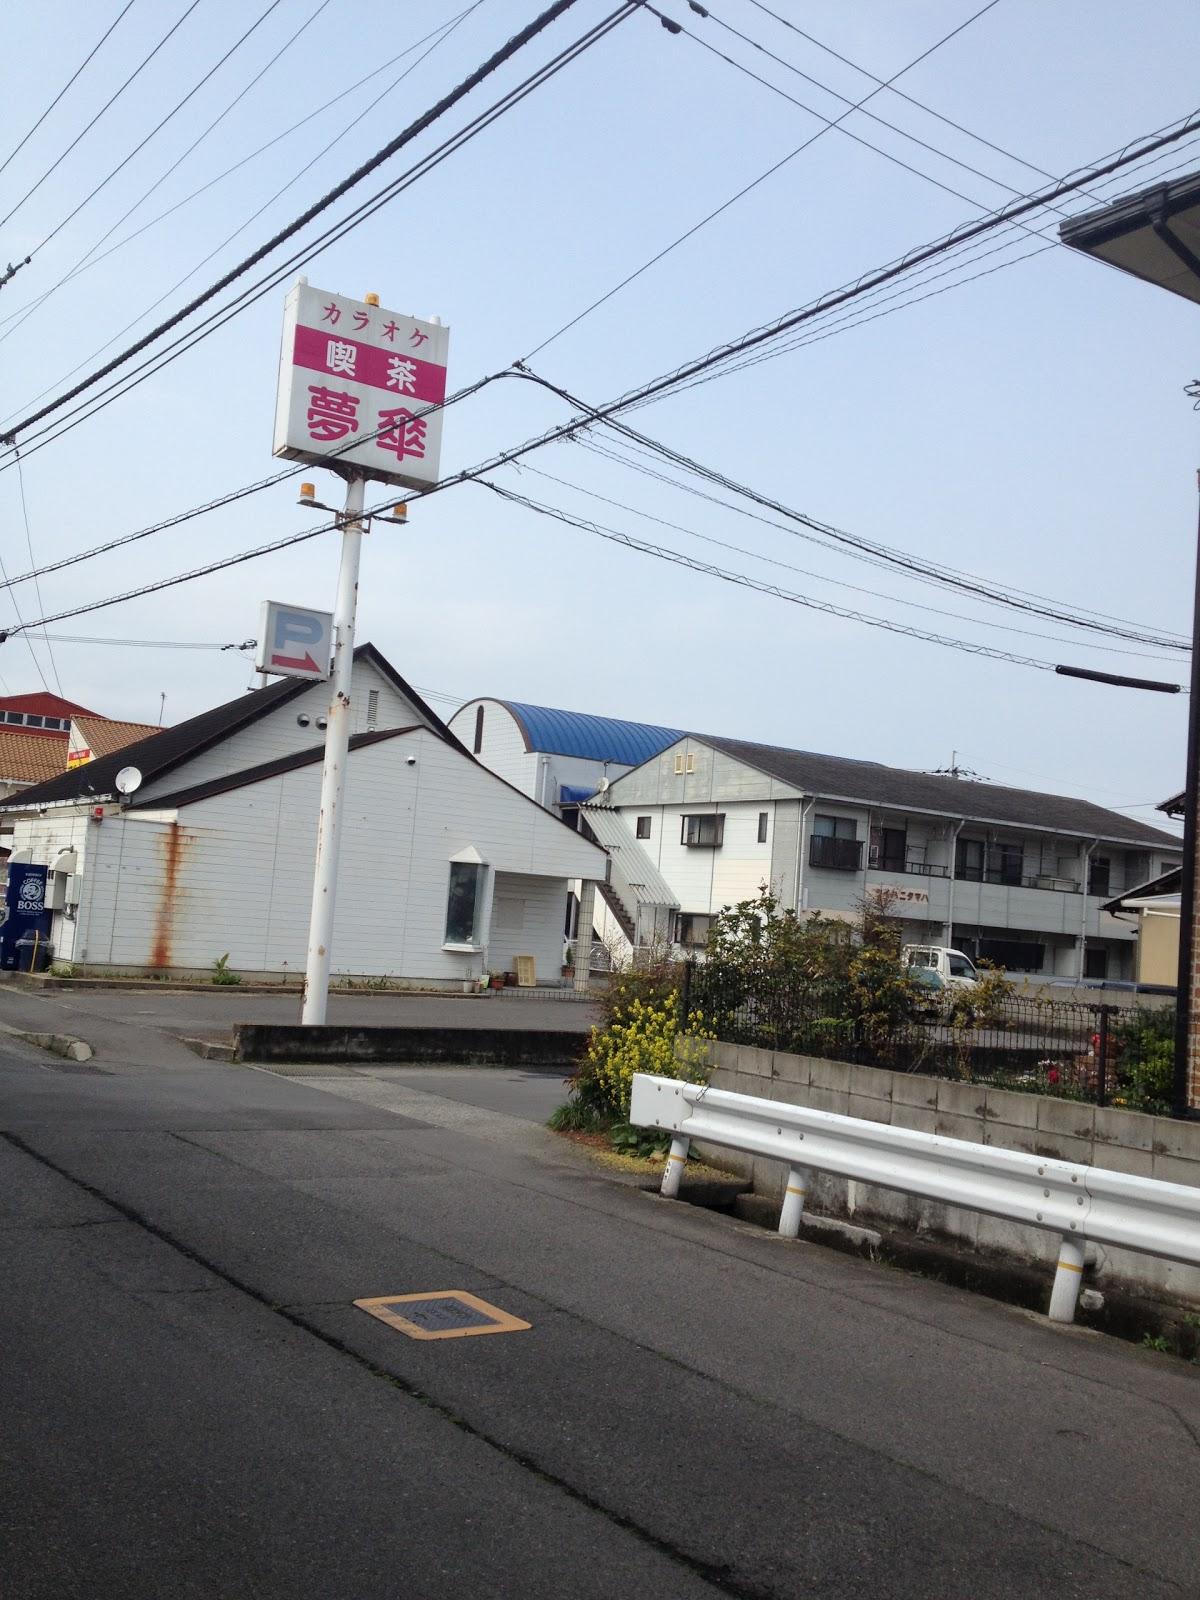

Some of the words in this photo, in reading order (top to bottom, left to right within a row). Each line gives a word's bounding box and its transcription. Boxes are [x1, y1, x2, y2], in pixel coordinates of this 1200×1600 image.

[320, 302, 429, 348] カラオケ
[326, 340, 417, 393] 喫茶
[307, 384, 428, 462] 夢傘
[274, 611, 324, 650] P
[17, 900, 44, 911] BOSS
